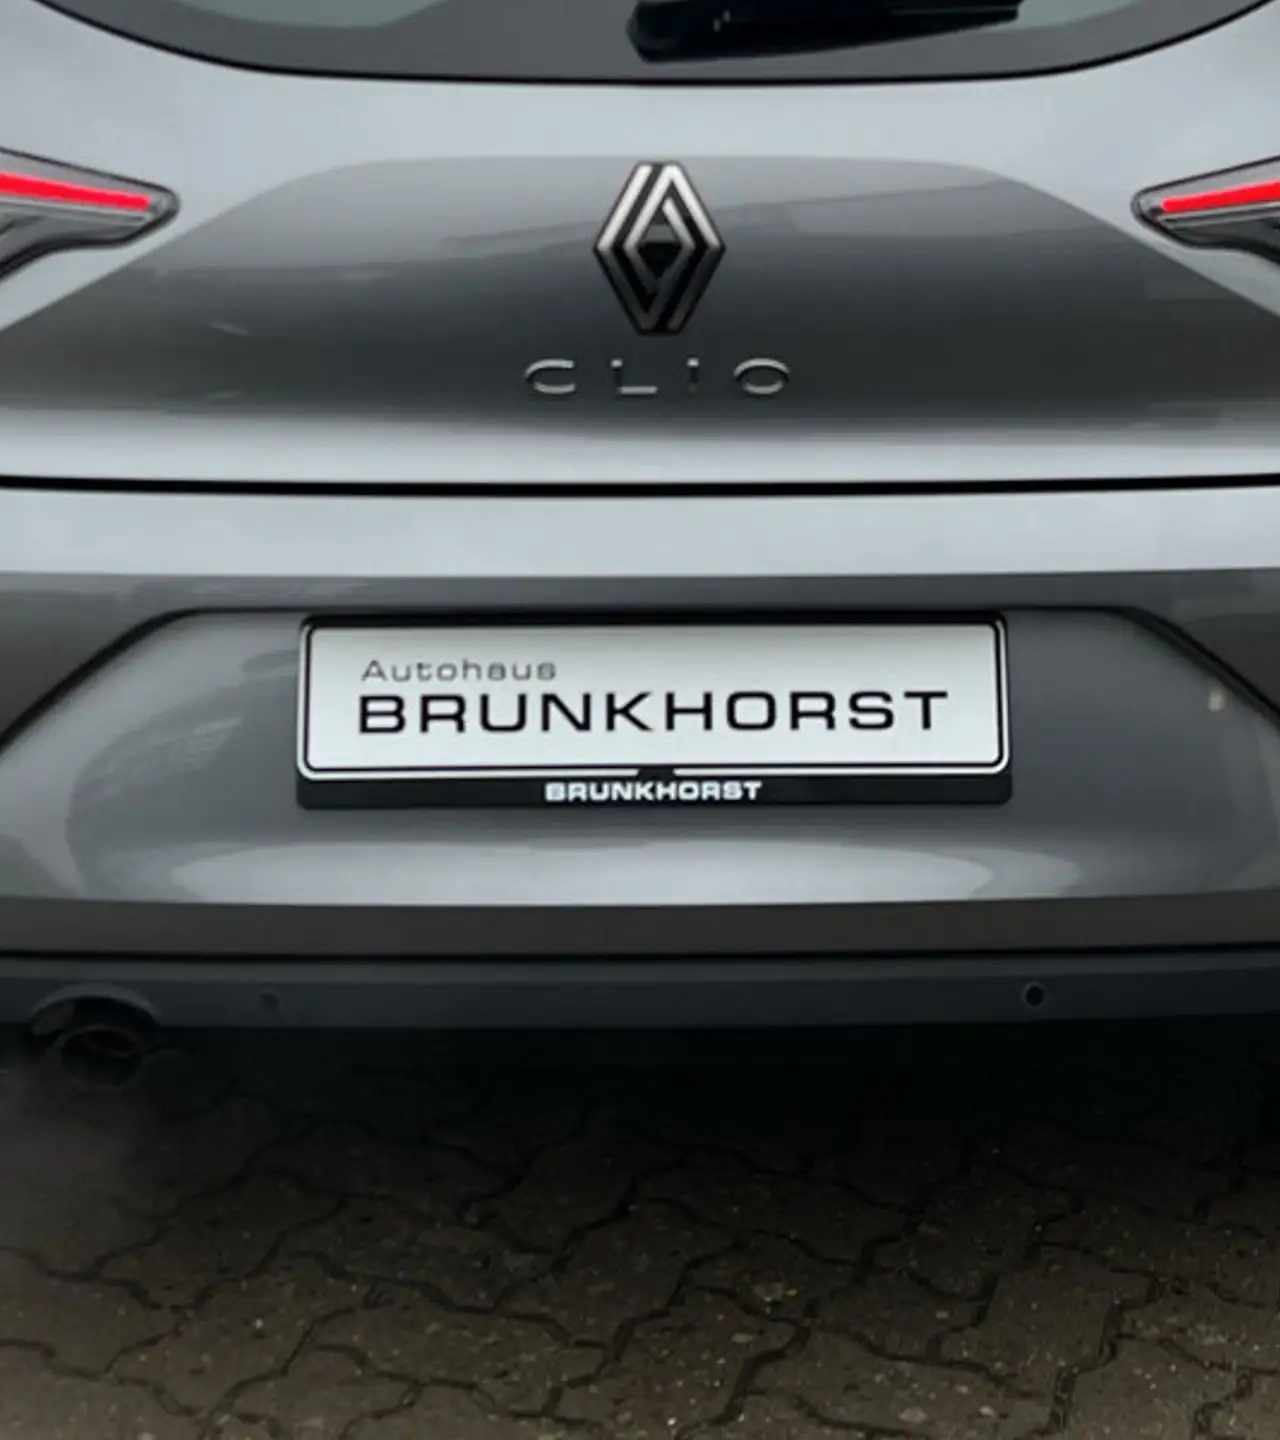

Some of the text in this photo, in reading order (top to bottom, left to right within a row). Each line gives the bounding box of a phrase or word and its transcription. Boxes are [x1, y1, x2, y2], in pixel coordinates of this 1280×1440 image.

[523, 357, 791, 396] CLIO
[361, 659, 558, 682] Autohaus
[358, 690, 949, 734] BRUNKHORST
[545, 782, 763, 802] BRUNKHORST
